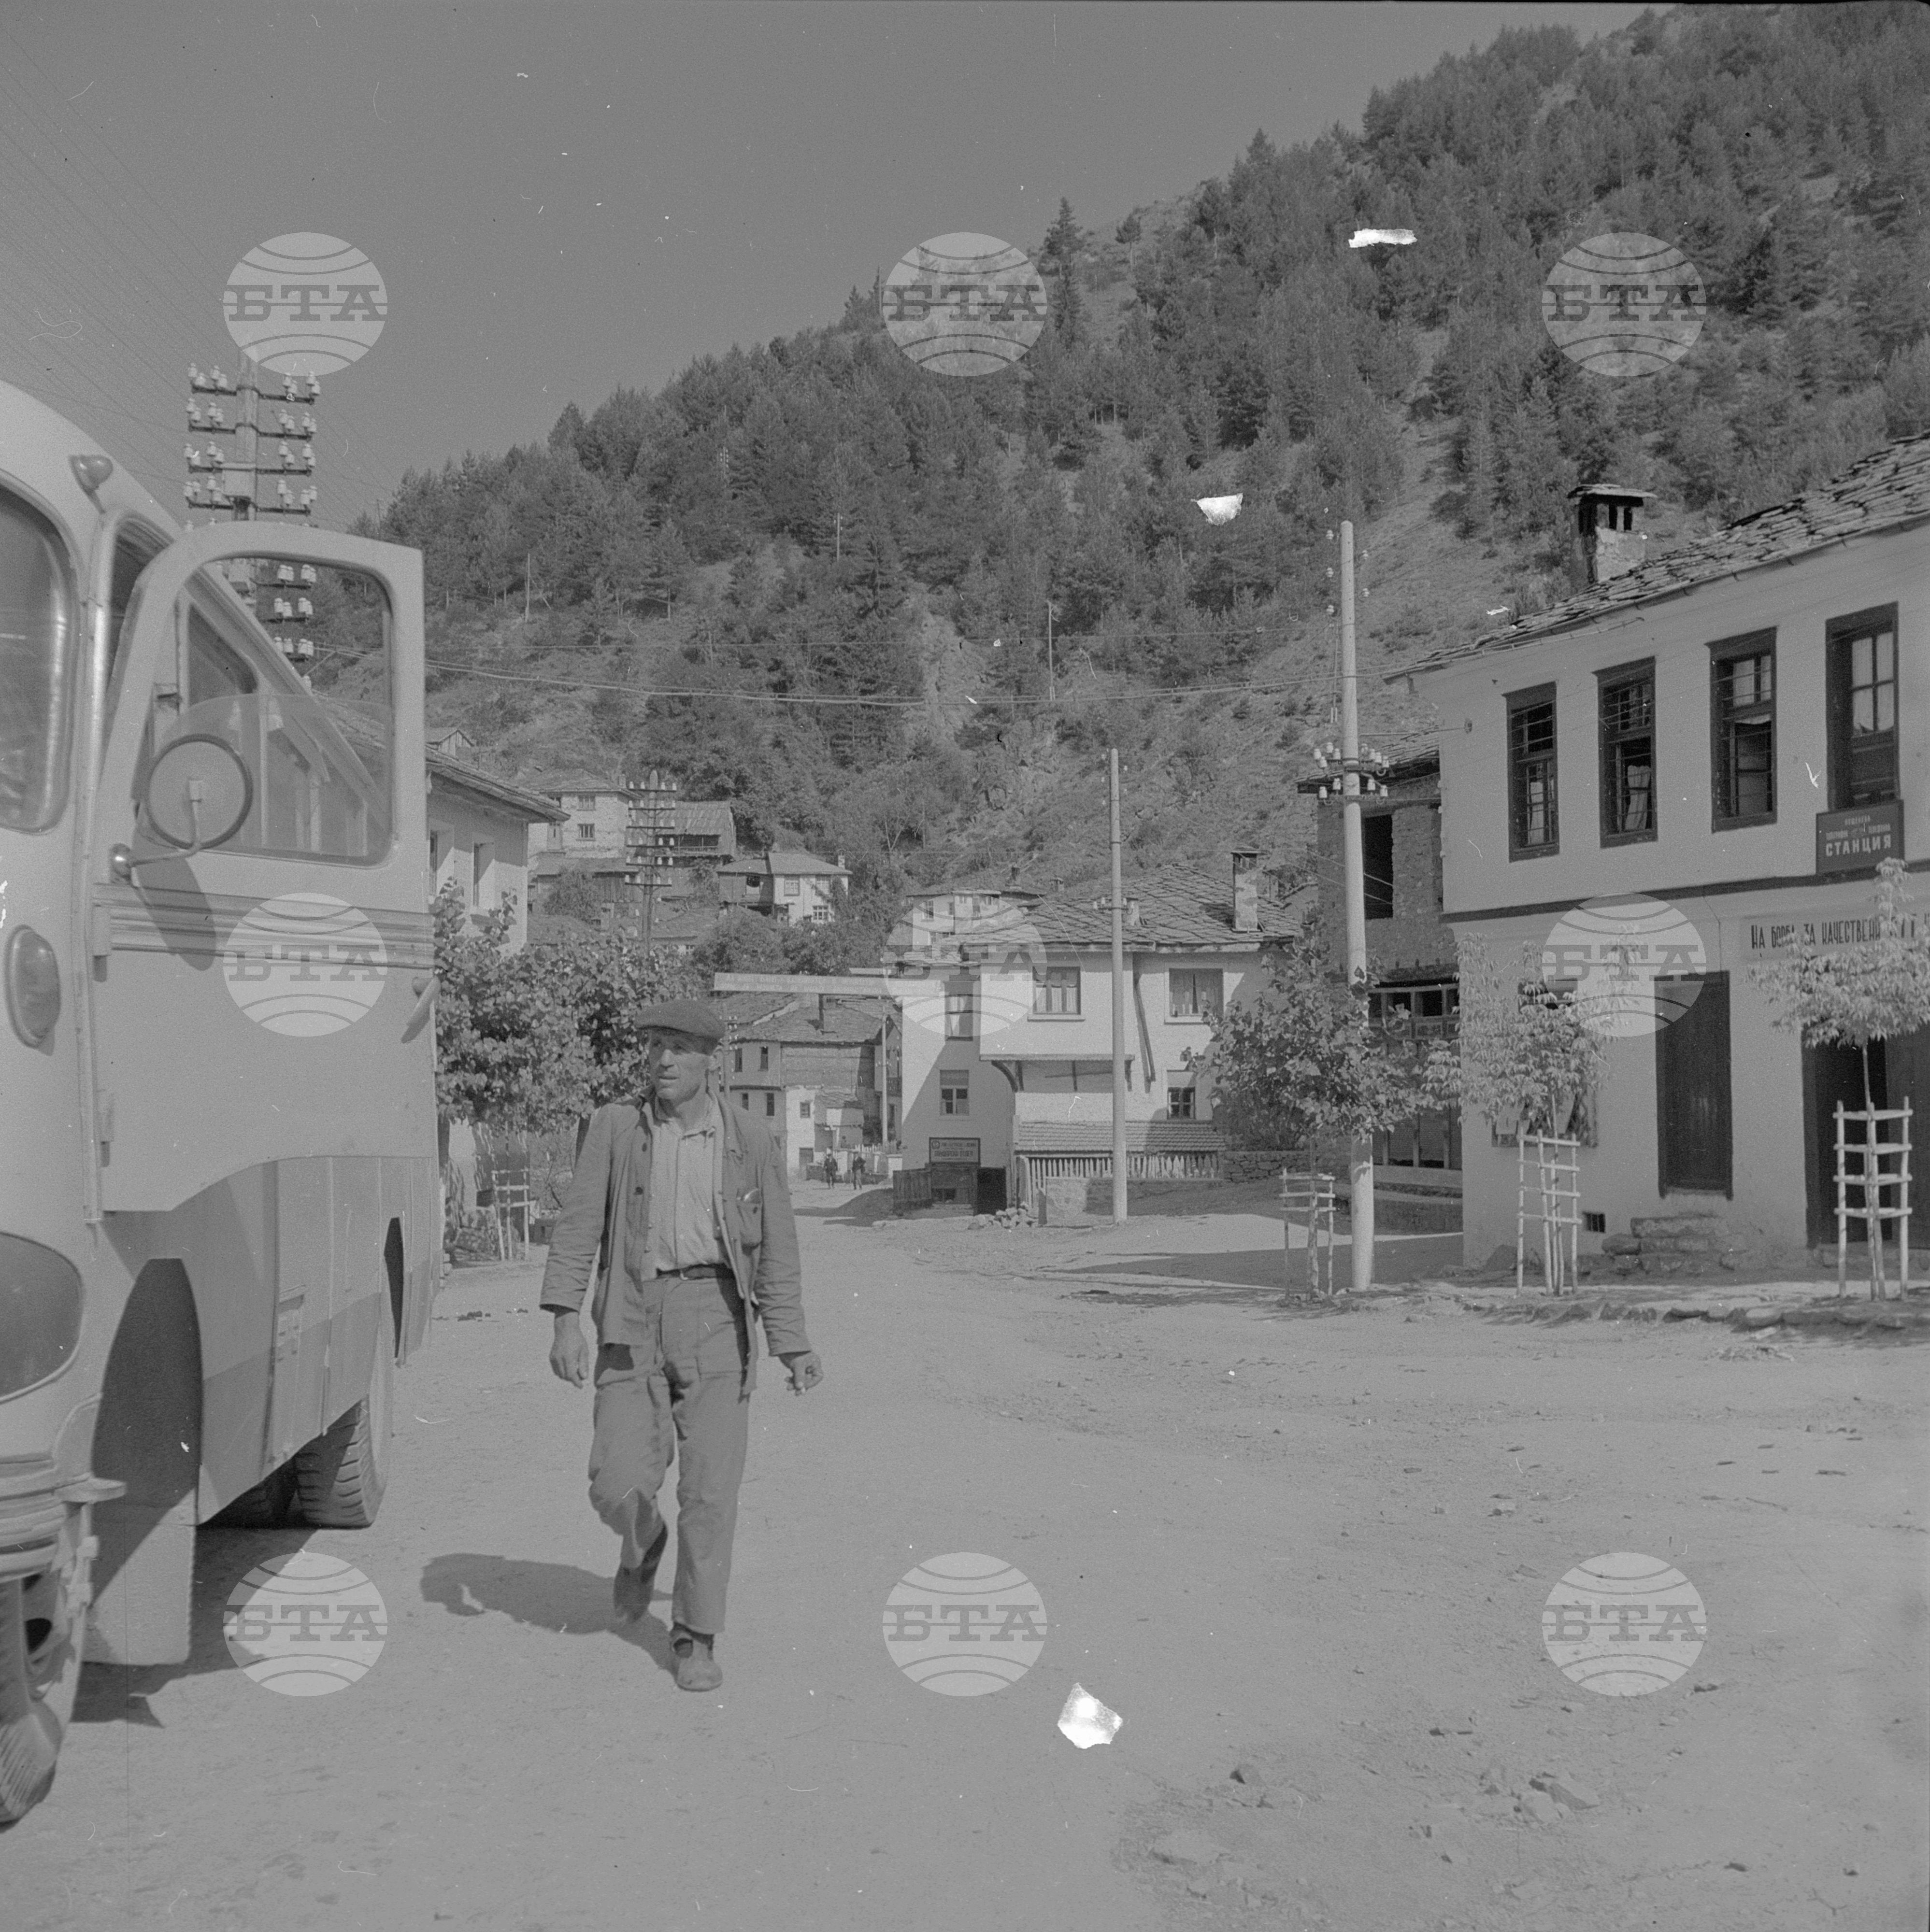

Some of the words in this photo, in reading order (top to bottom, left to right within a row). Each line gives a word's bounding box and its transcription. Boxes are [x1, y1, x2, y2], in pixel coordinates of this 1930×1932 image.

[1825, 834, 1891, 857] СТАНЦИЯ
[1751, 924, 1766, 950] НА
[1803, 923, 1816, 946] ЗА
